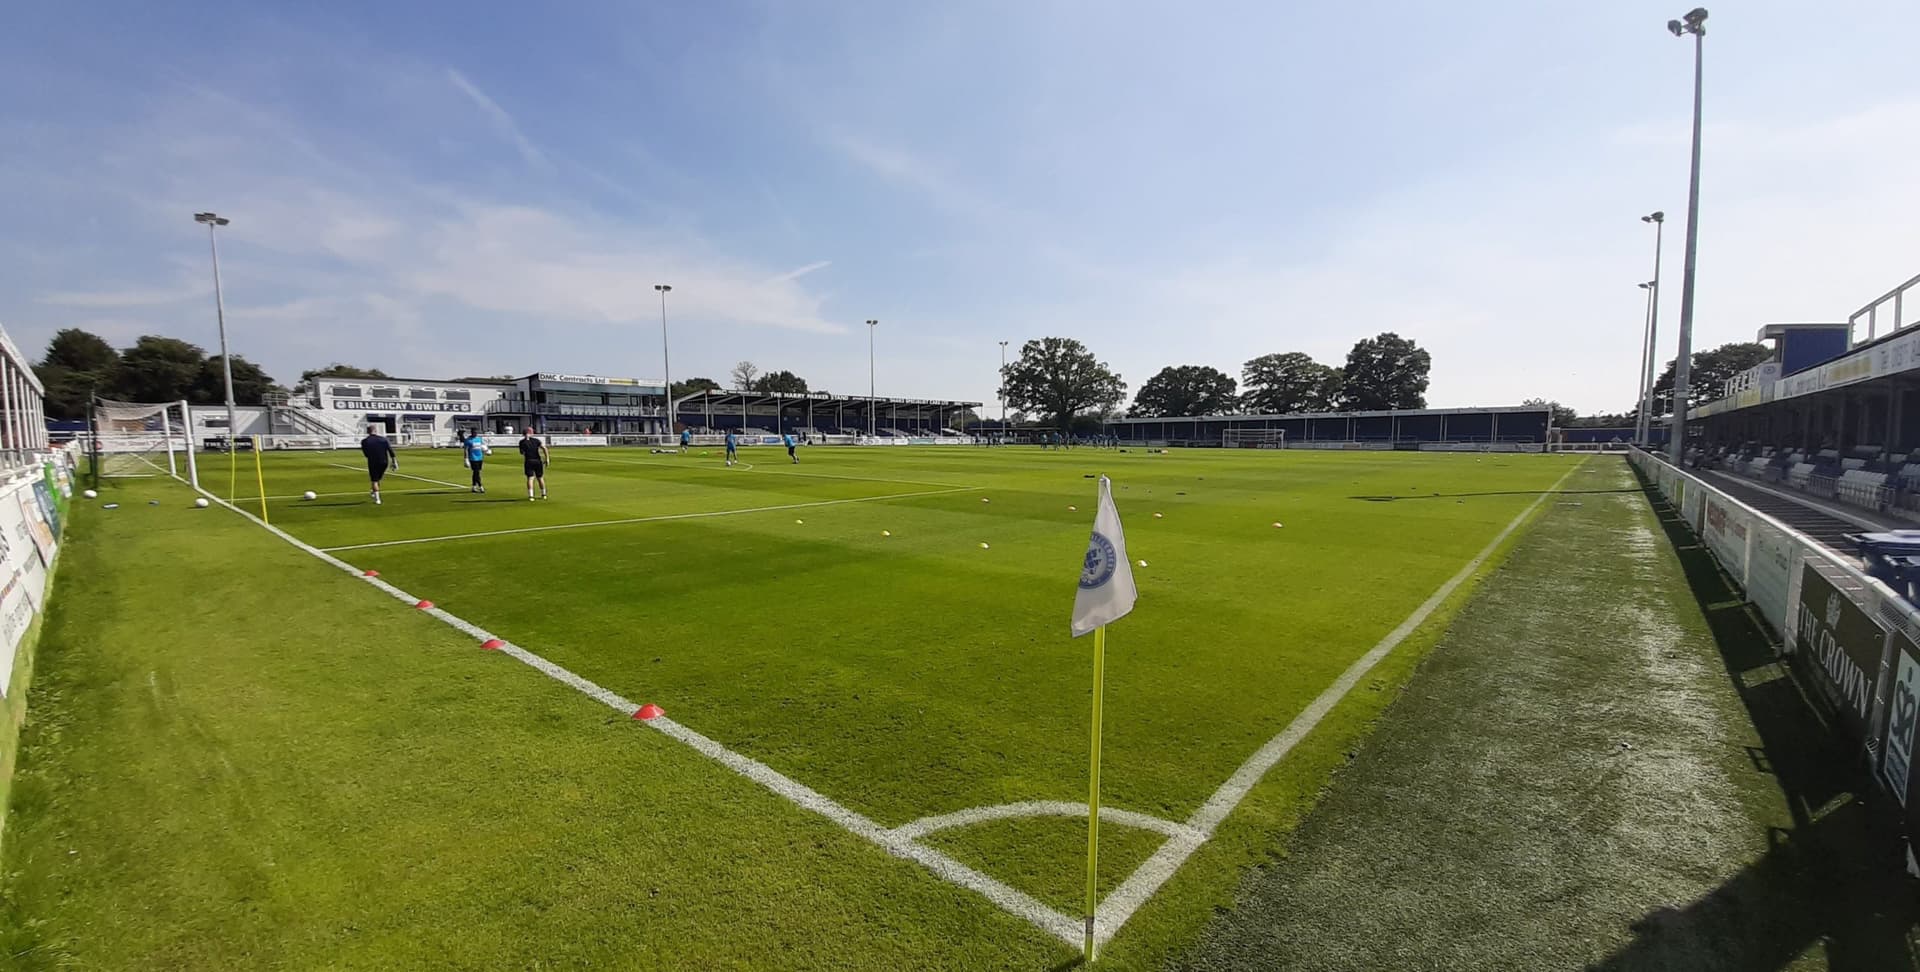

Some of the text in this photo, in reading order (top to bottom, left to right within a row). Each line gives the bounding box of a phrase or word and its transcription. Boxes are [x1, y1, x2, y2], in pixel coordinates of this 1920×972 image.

[559, 375, 593, 383] Contracts
[348, 401, 407, 411] BILLERICAY
[411, 402, 440, 411] TOWN
[1800, 601, 1818, 651] THE
[1819, 629, 1873, 719] CROWN
